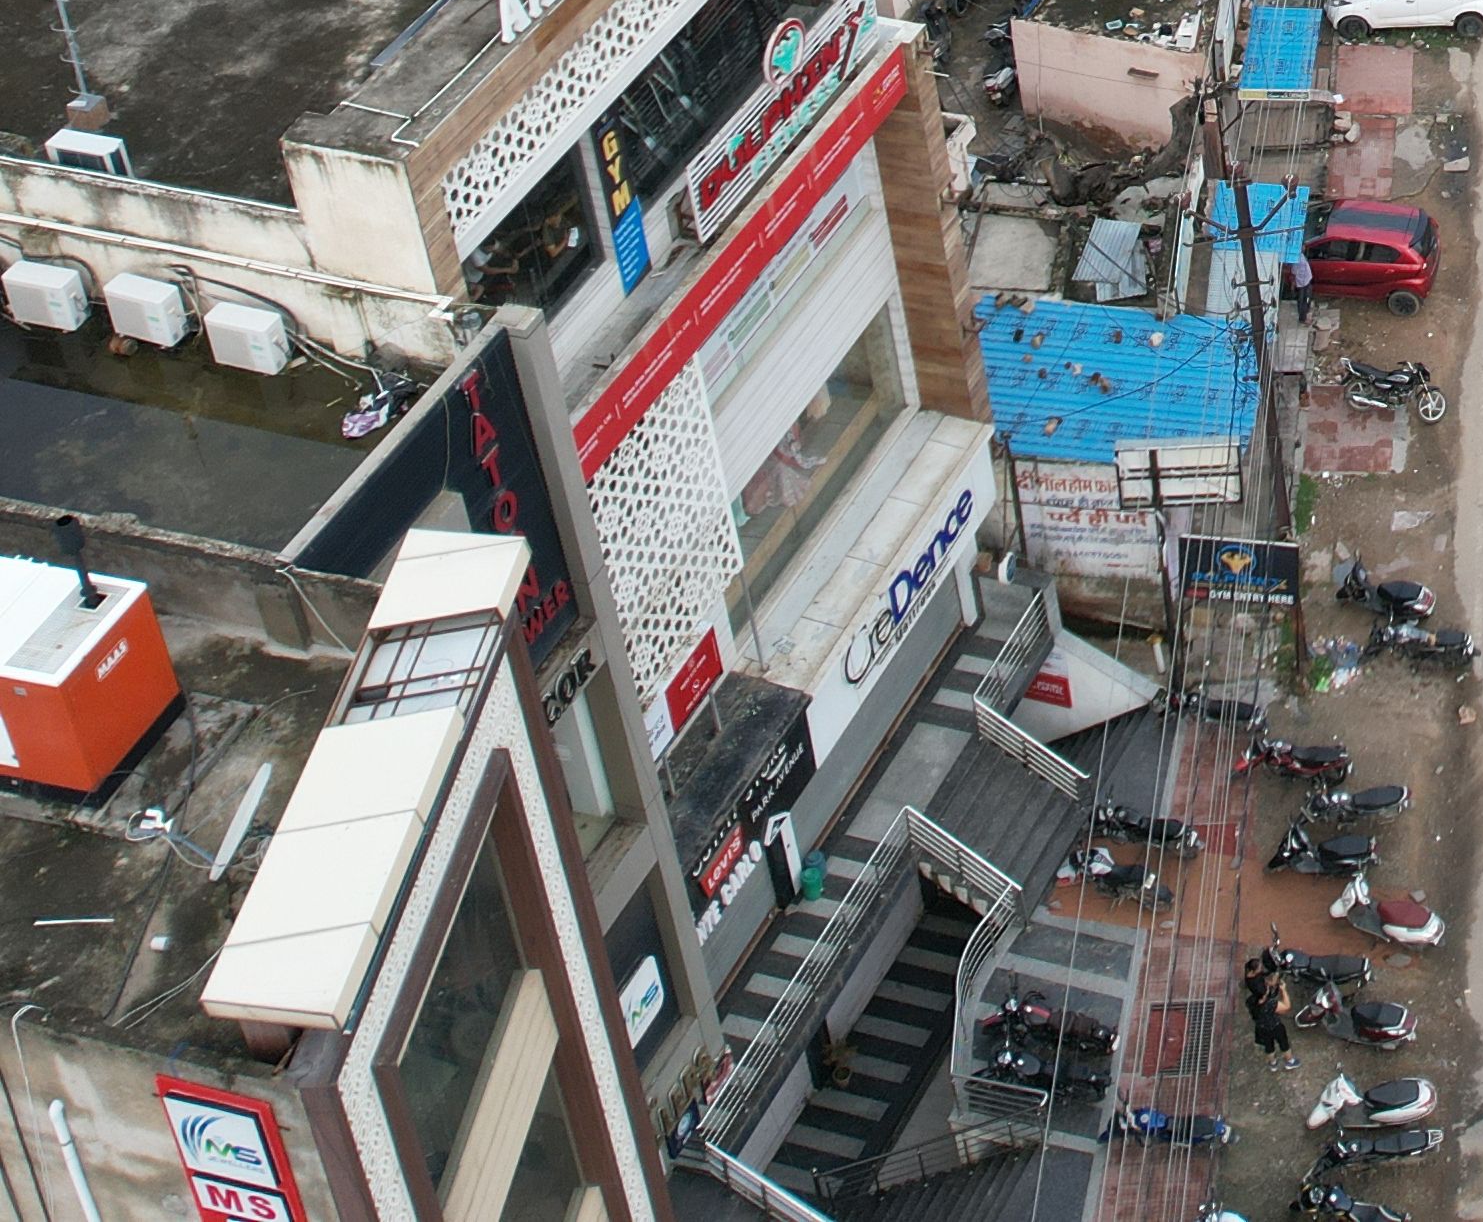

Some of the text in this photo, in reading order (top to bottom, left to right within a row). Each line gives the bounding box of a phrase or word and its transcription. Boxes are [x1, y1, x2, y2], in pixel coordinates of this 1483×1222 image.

[602, 130, 631, 217] GYM
[522, 580, 570, 645] WER
[751, 741, 806, 823] PARK AVENUE
